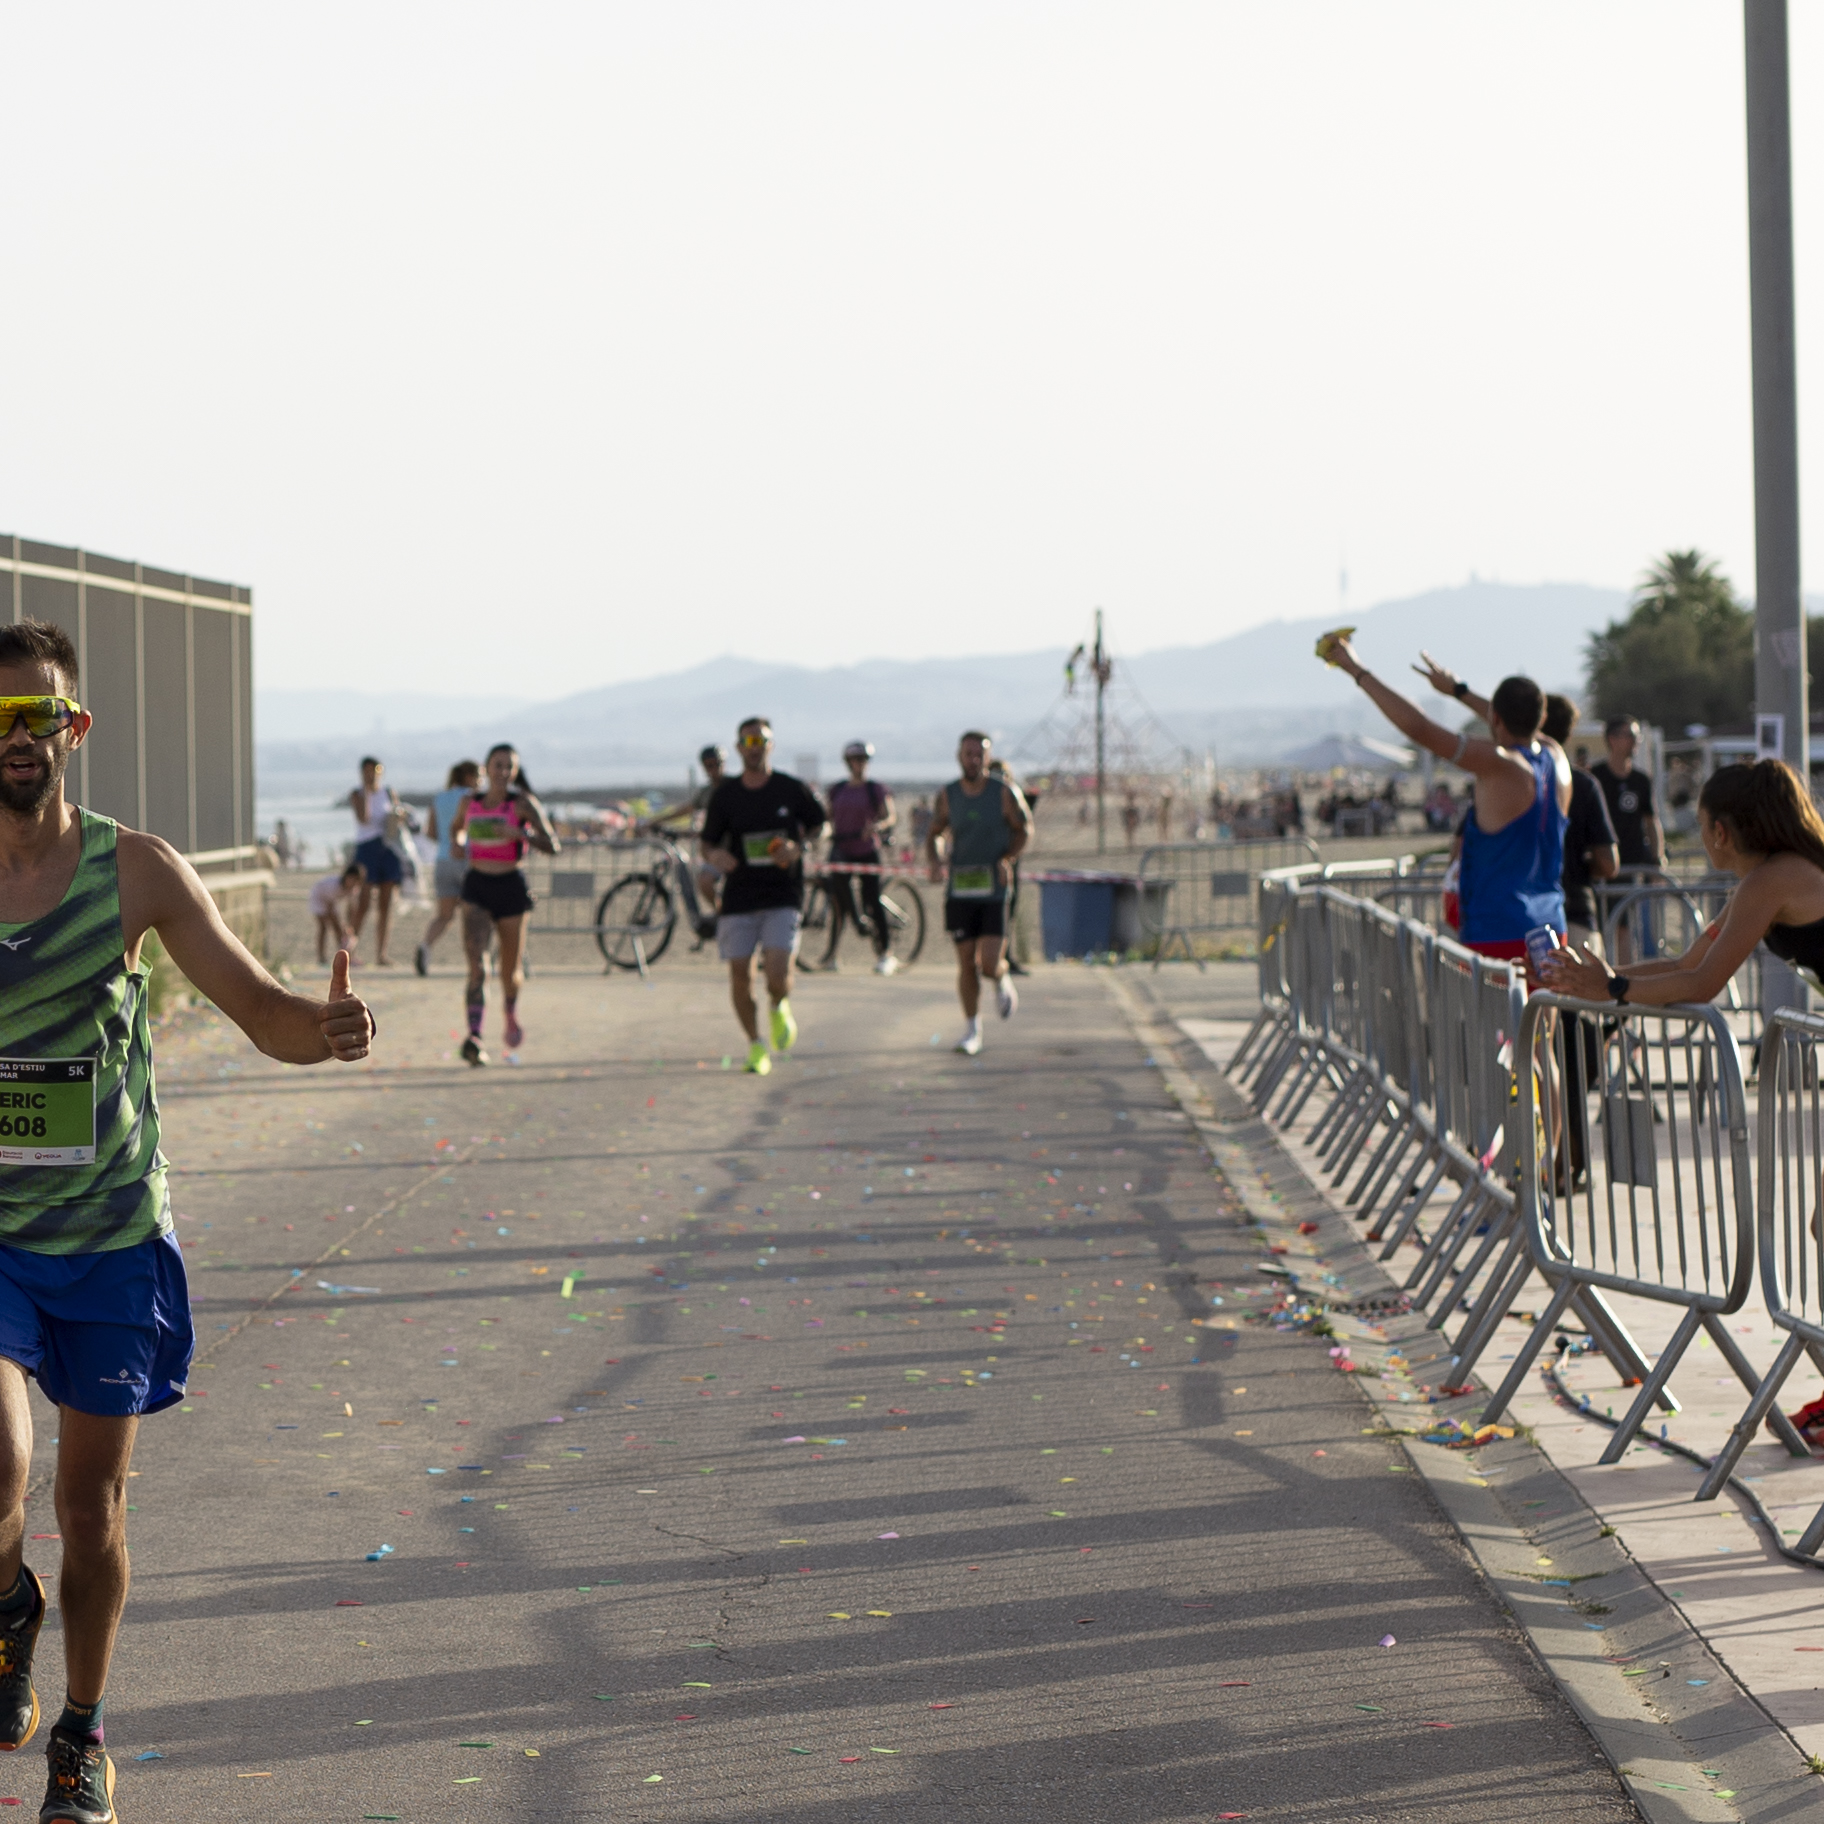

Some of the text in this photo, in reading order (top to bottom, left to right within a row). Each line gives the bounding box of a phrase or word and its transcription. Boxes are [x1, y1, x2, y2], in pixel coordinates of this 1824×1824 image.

[12, 1063, 46, 1072] D'ESTIU
[68, 1065, 85, 1076] 5K
[0, 1092, 46, 1109] ERIC
